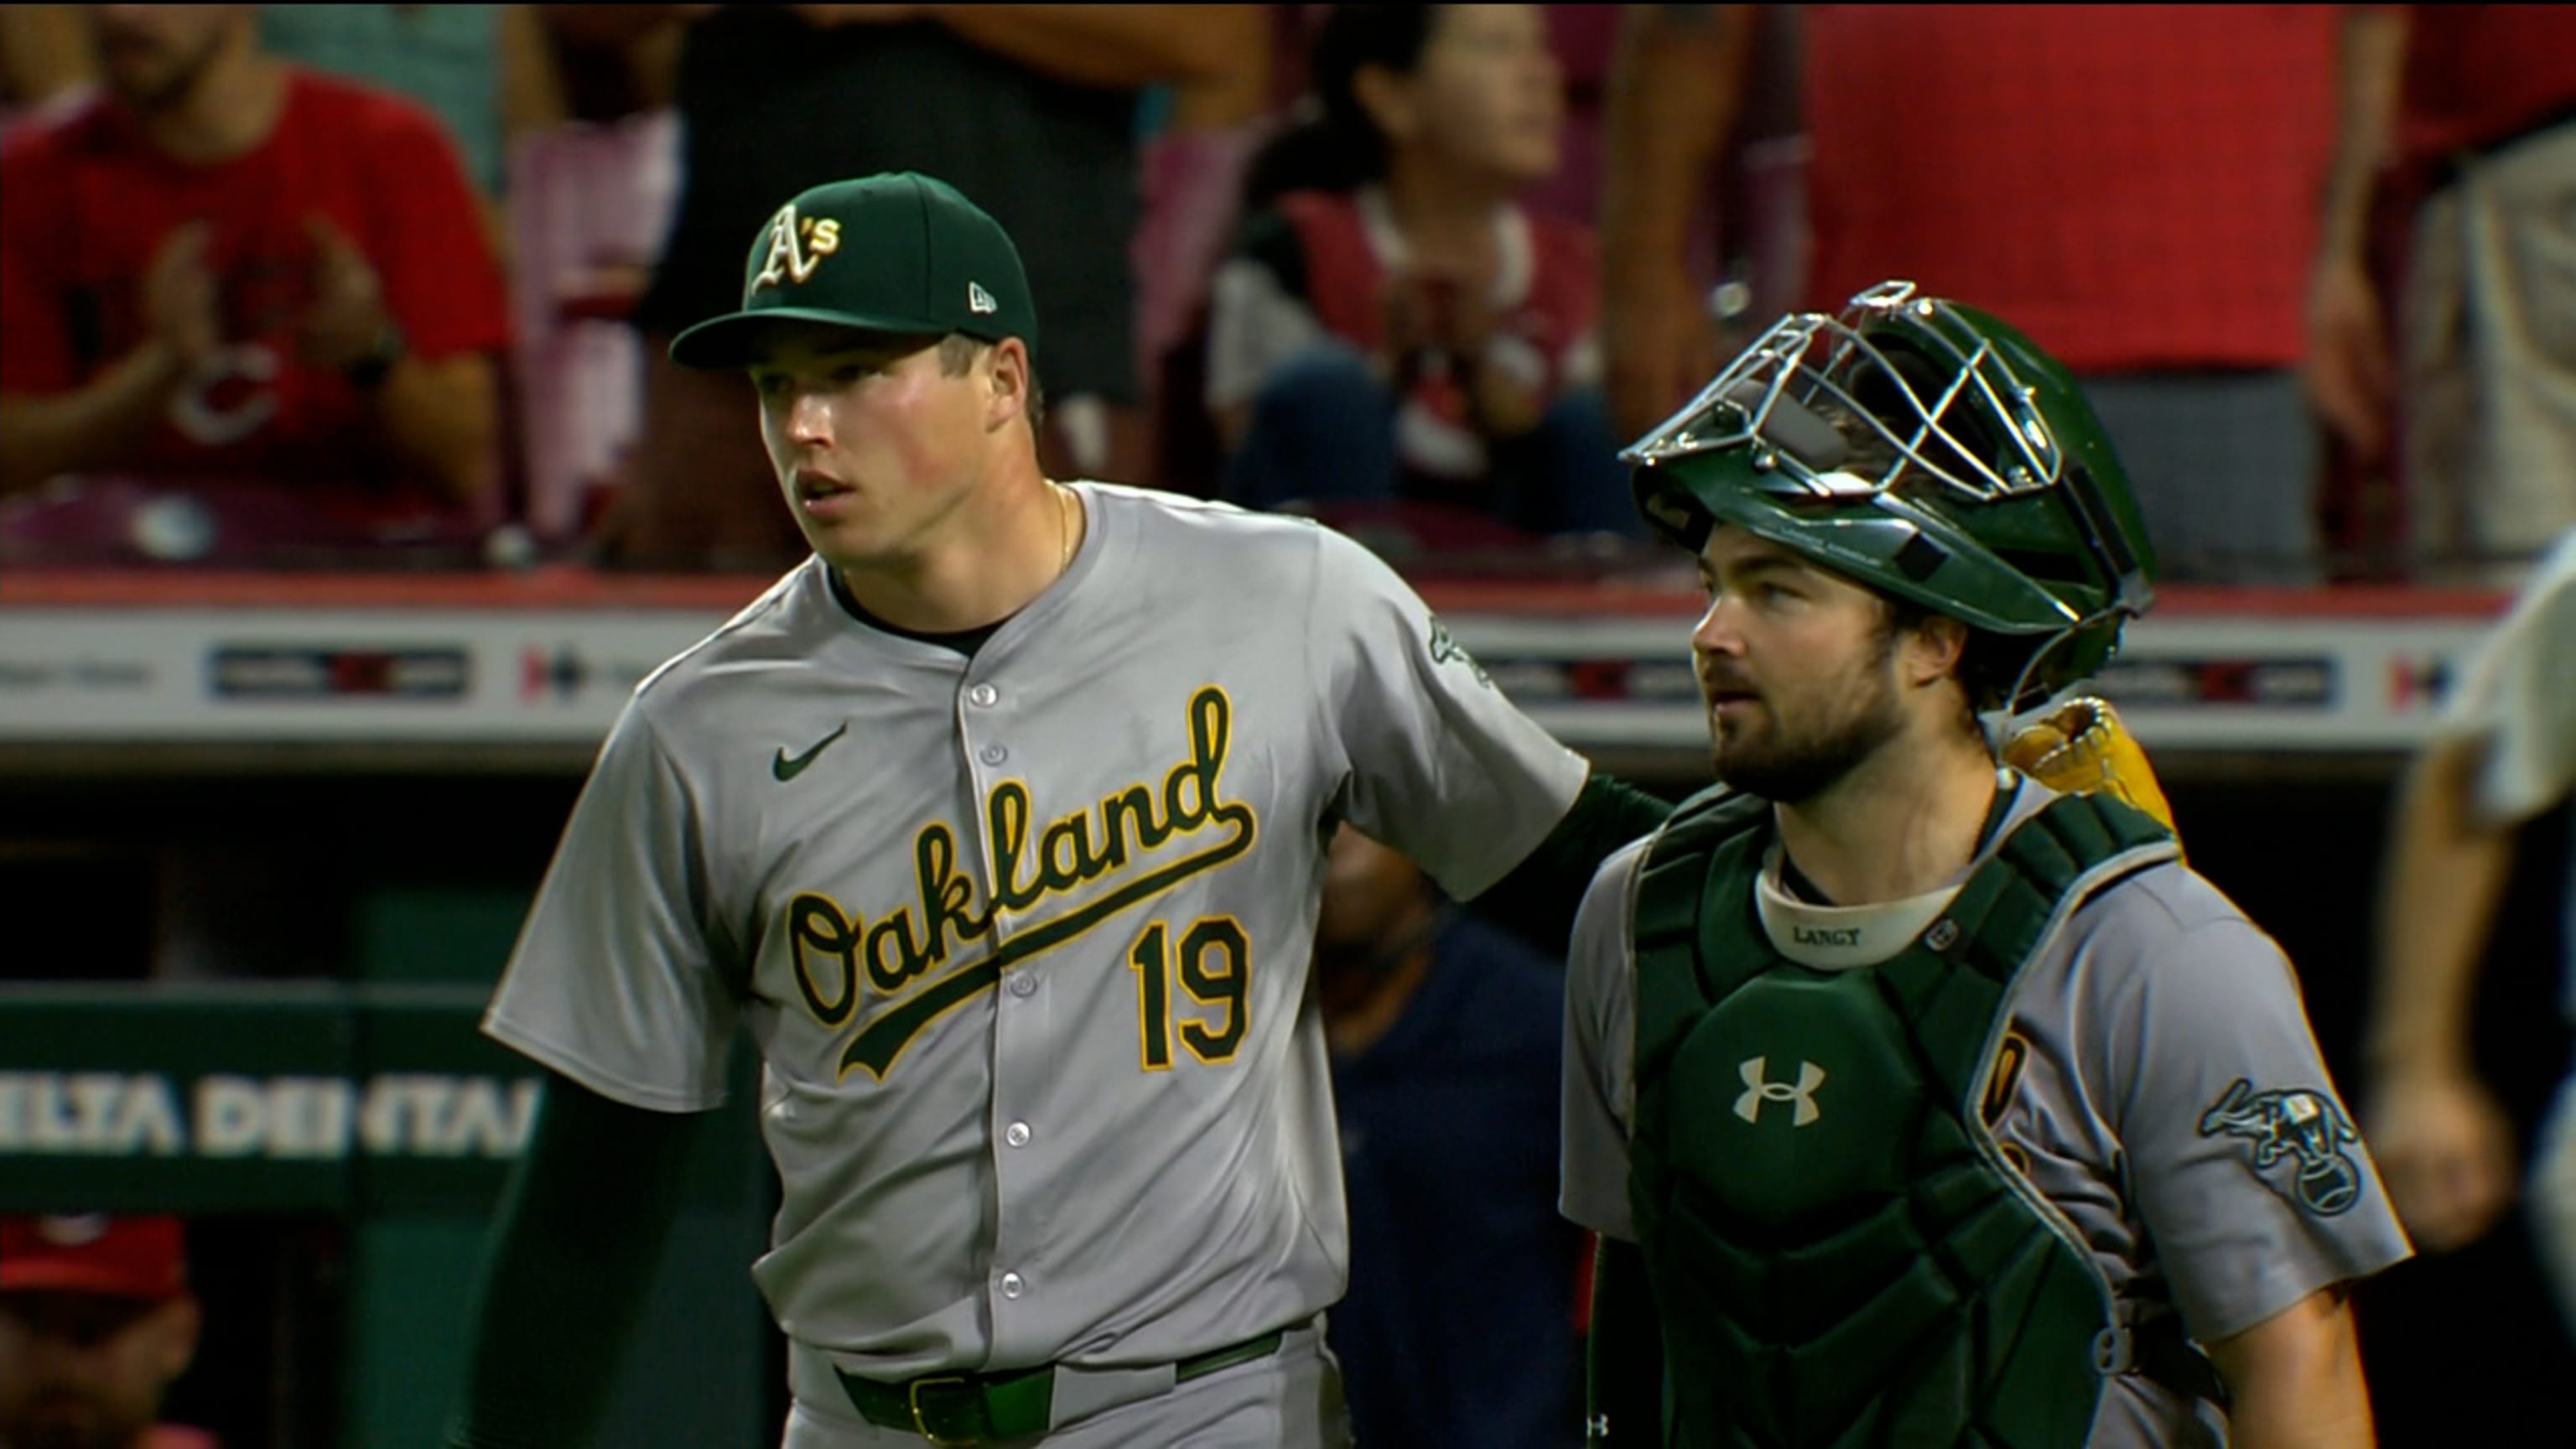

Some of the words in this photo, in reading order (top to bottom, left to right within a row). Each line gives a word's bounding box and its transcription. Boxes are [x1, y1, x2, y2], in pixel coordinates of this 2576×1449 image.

[752, 204, 841, 295] A's
[787, 683, 1256, 1030] Oakland
[1127, 916, 1252, 1072] 19
[1793, 926, 1861, 947] LANGY
